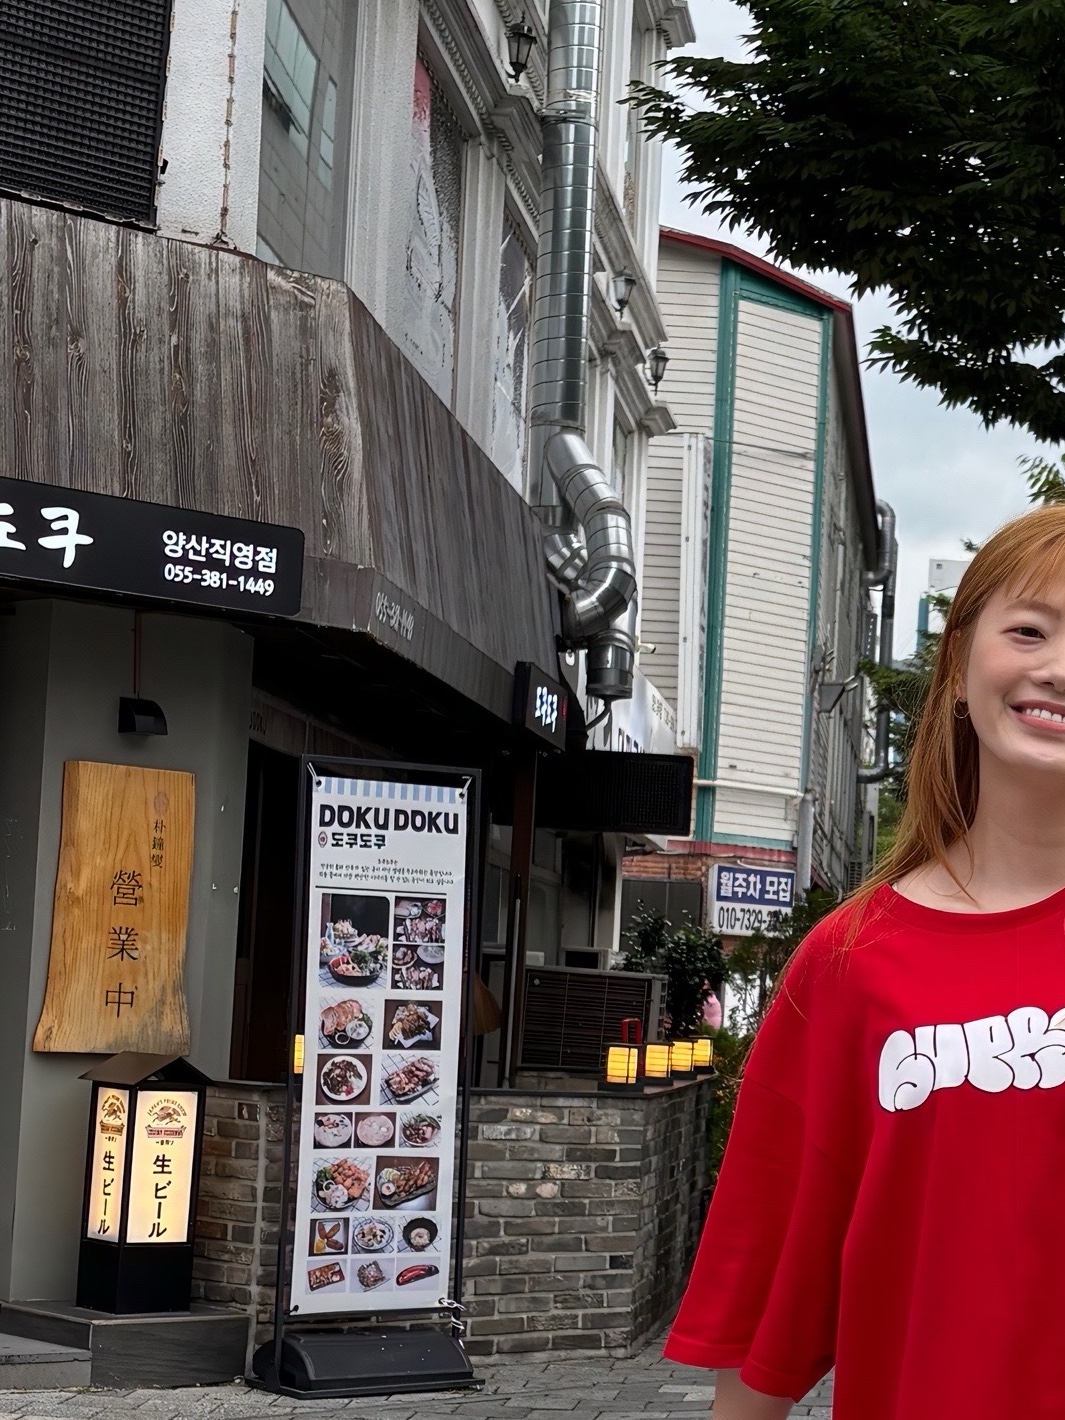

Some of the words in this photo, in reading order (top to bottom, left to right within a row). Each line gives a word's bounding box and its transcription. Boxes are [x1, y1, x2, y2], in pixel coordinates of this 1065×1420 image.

[162, 530, 278, 573] 양산직영점
[164, 563, 275, 597] 055-381-1449
[319, 804, 390, 830] DOKU
[393, 808, 459, 834] DOKU
[331, 832, 386, 849] 도쿠도쿠
[720, 871, 762, 900] 월주차
[764, 875, 792, 903] 모집
[105, 869, 143, 1018] 營業中
[98, 1150, 115, 1235] 生ビール
[148, 1154, 172, 1238] 生ビール
